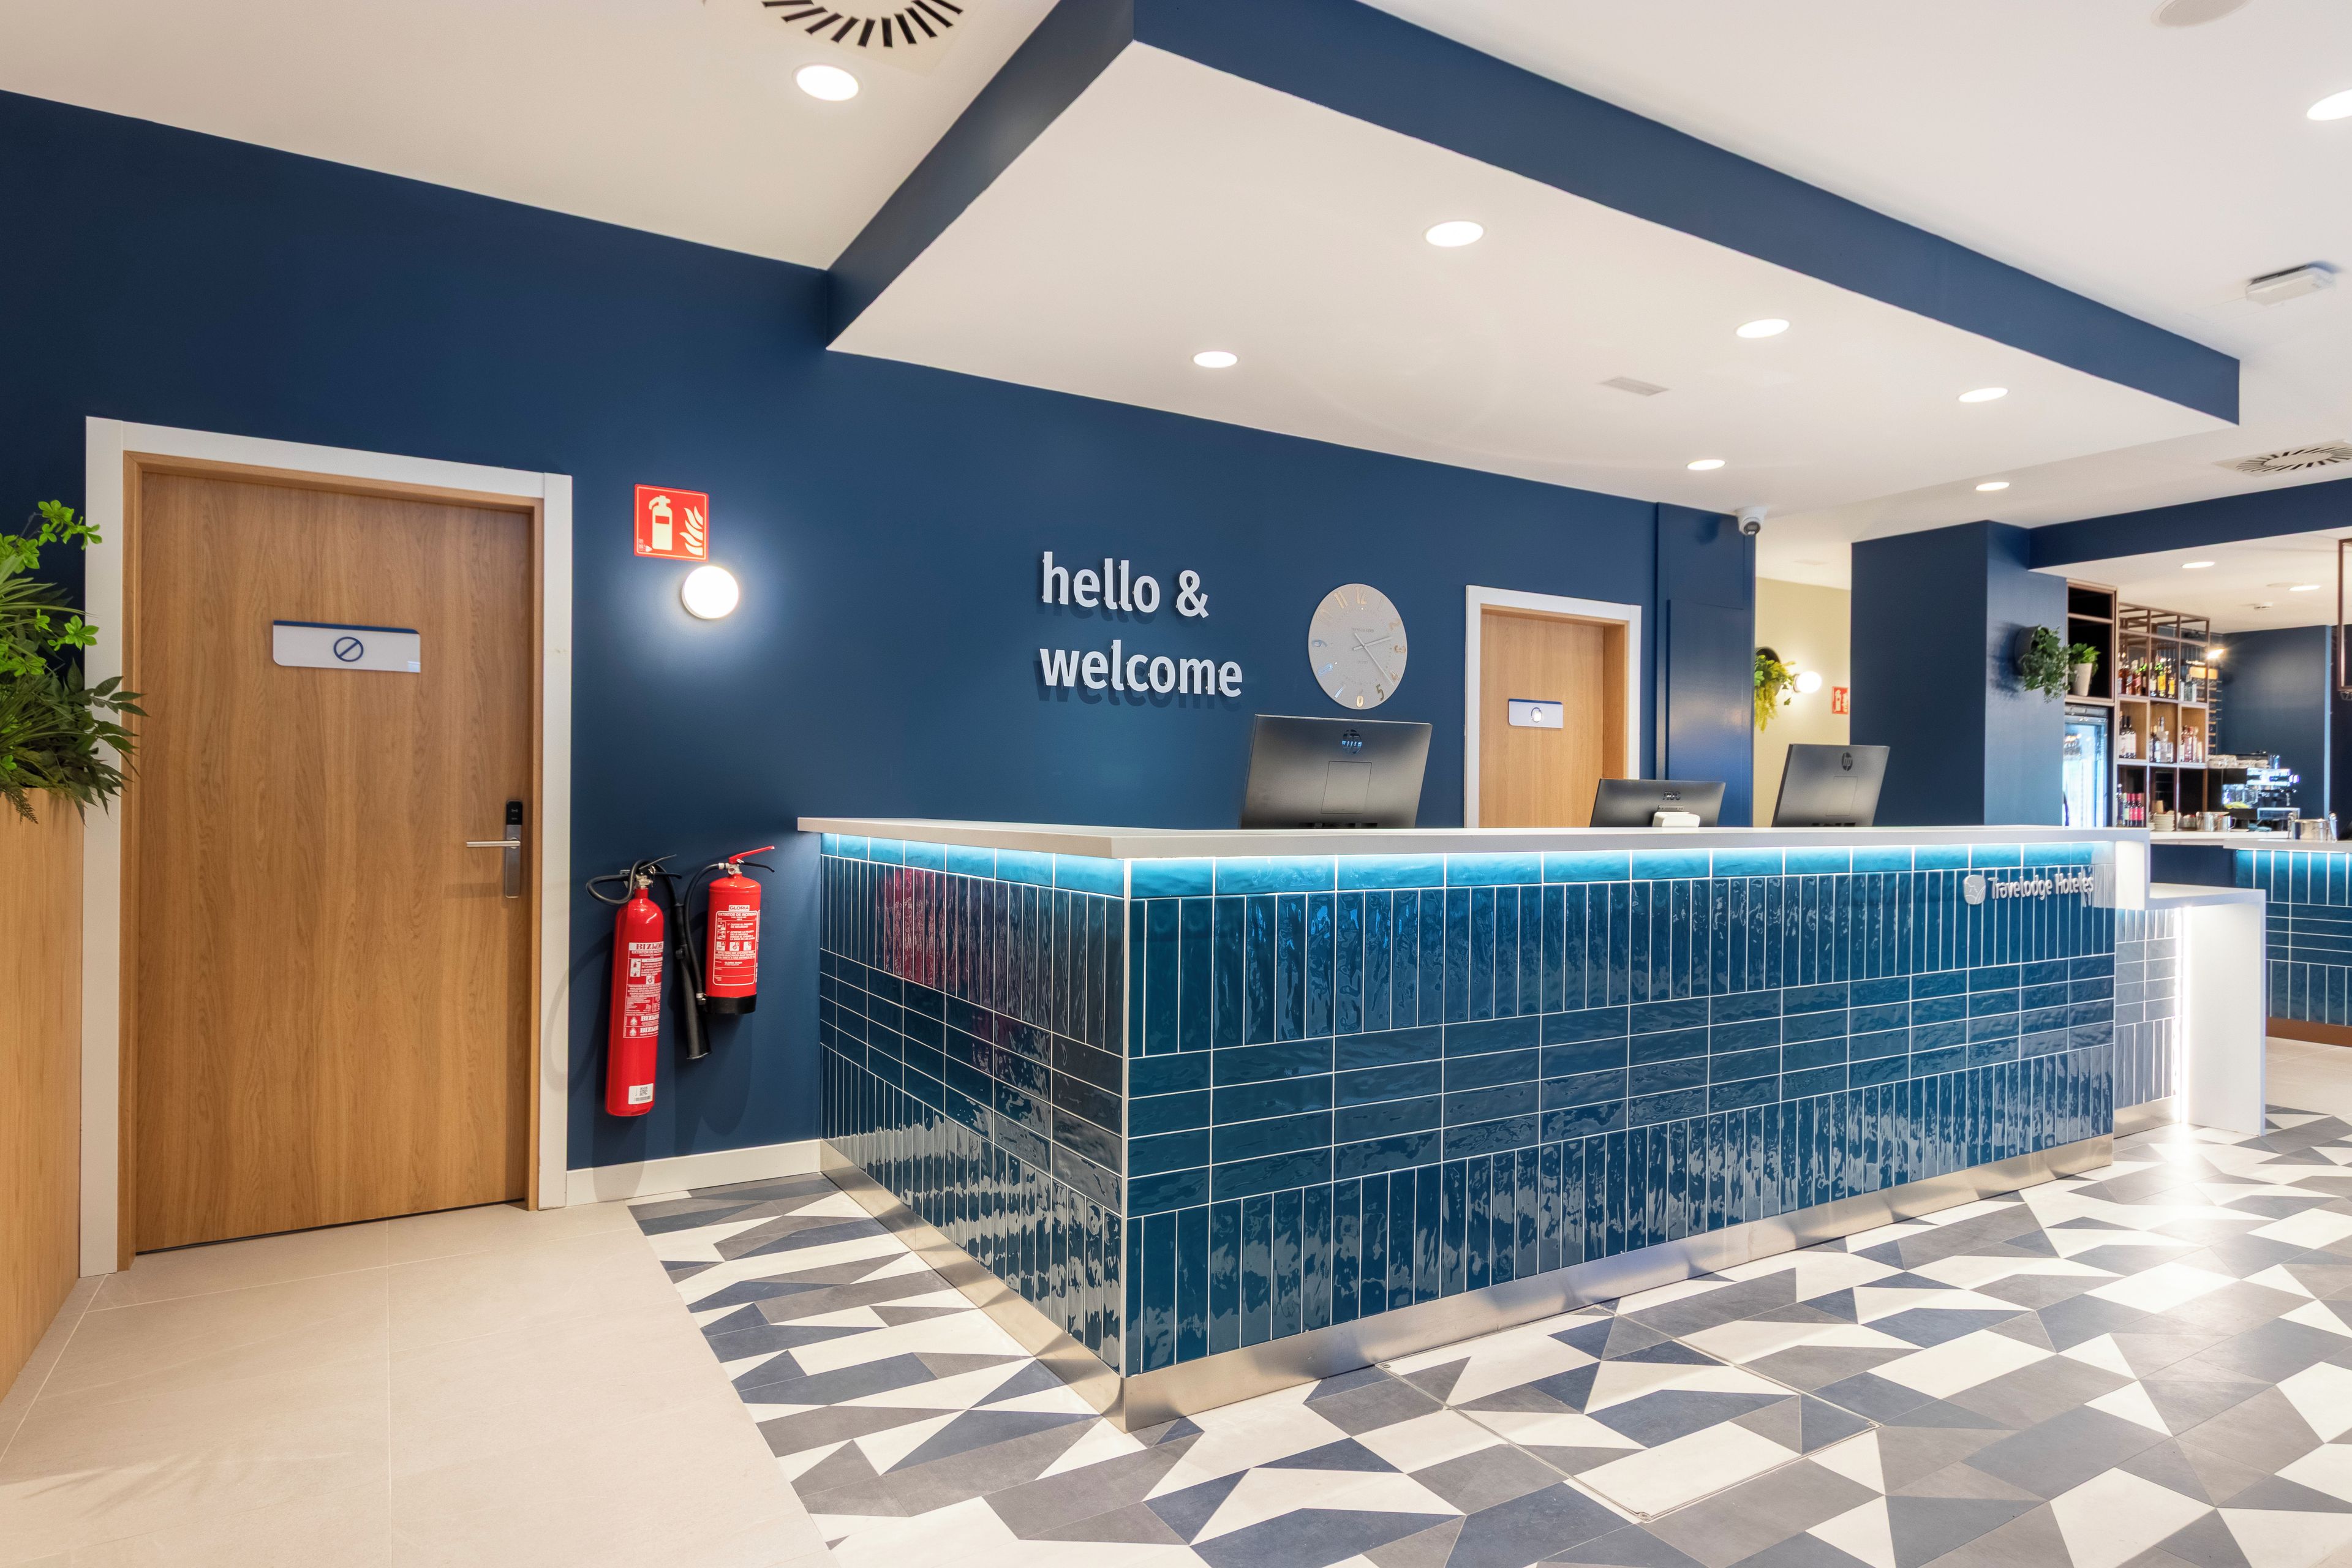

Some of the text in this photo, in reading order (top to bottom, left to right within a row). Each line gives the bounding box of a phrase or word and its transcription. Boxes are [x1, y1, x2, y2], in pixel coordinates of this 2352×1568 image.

[1043, 551, 1210, 619] hello &
[1039, 639, 1243, 697] welcome
[1376, 683, 1385, 702] 5
[1988, 872, 2094, 901] Travelodge Hoteles
